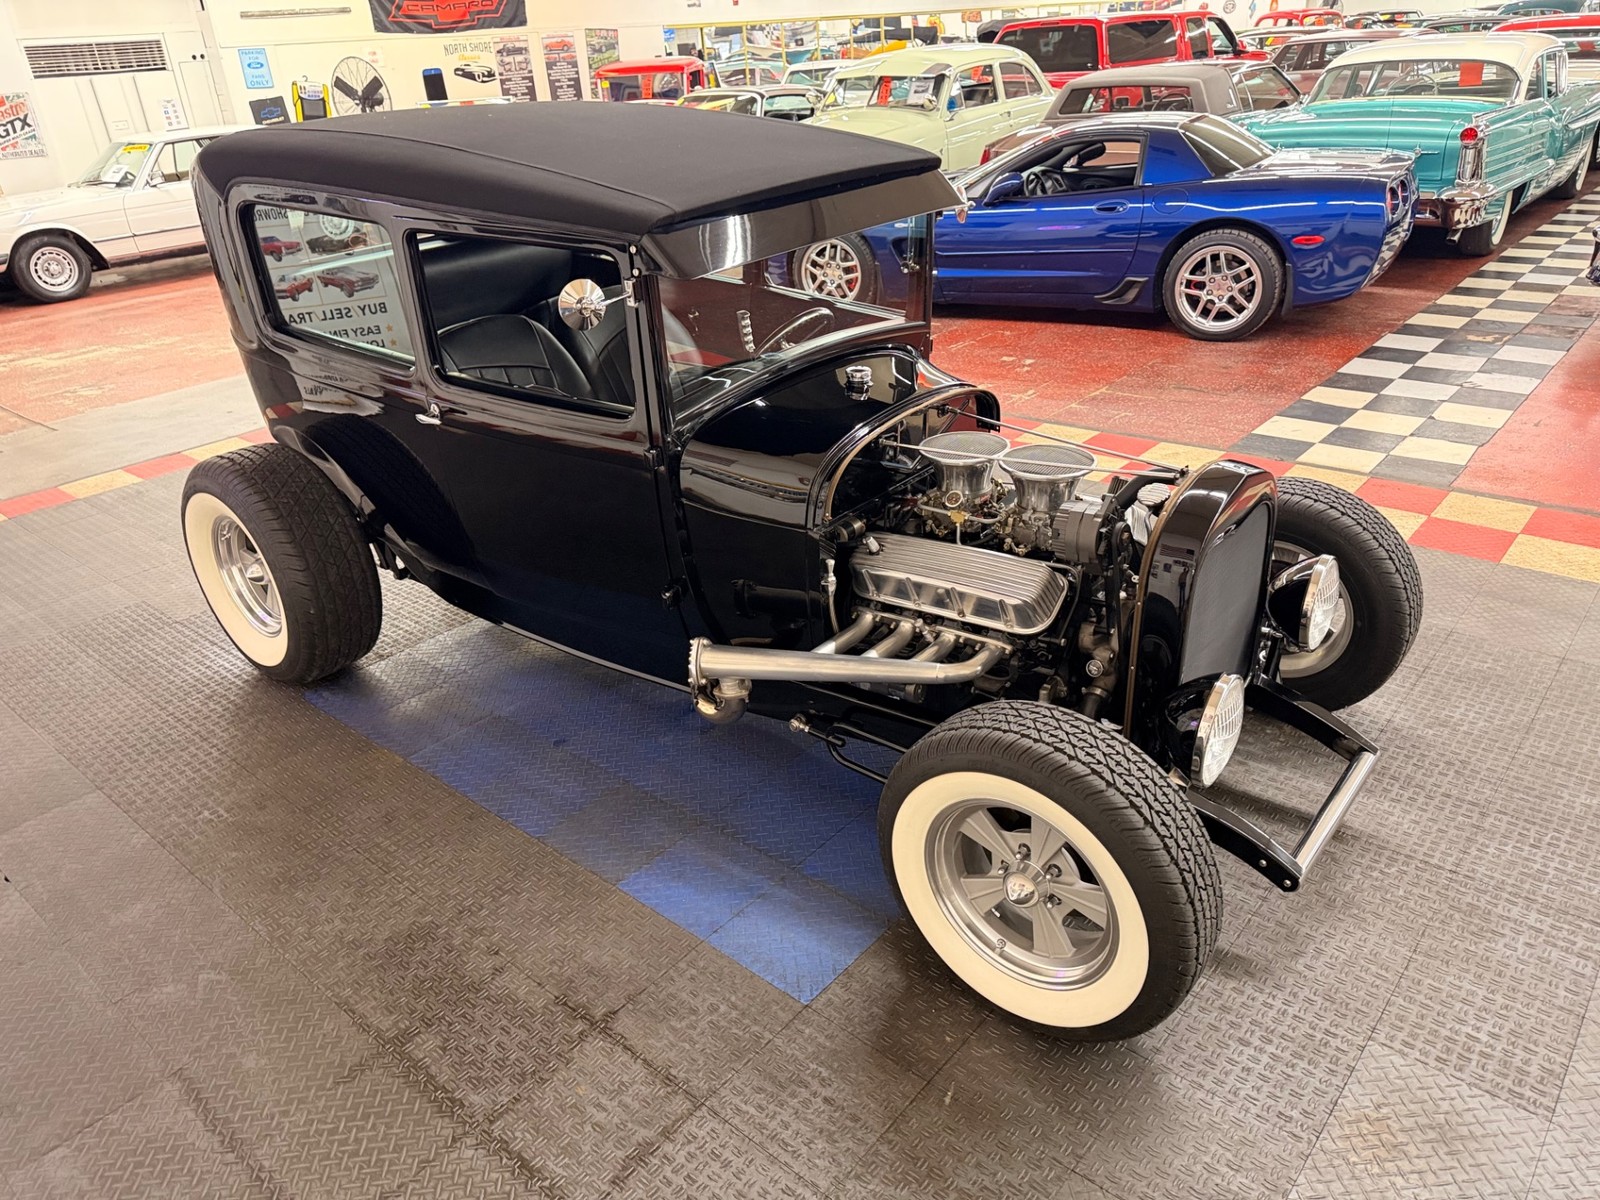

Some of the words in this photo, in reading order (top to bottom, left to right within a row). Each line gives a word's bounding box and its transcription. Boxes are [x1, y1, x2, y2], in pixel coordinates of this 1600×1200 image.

[406, 0, 494, 12] CAMARO
[443, 42, 468, 57] NORTH
[469, 41, 493, 54] SHORE
[0, 101, 28, 119] astro
[0, 113, 33, 139] GTX
